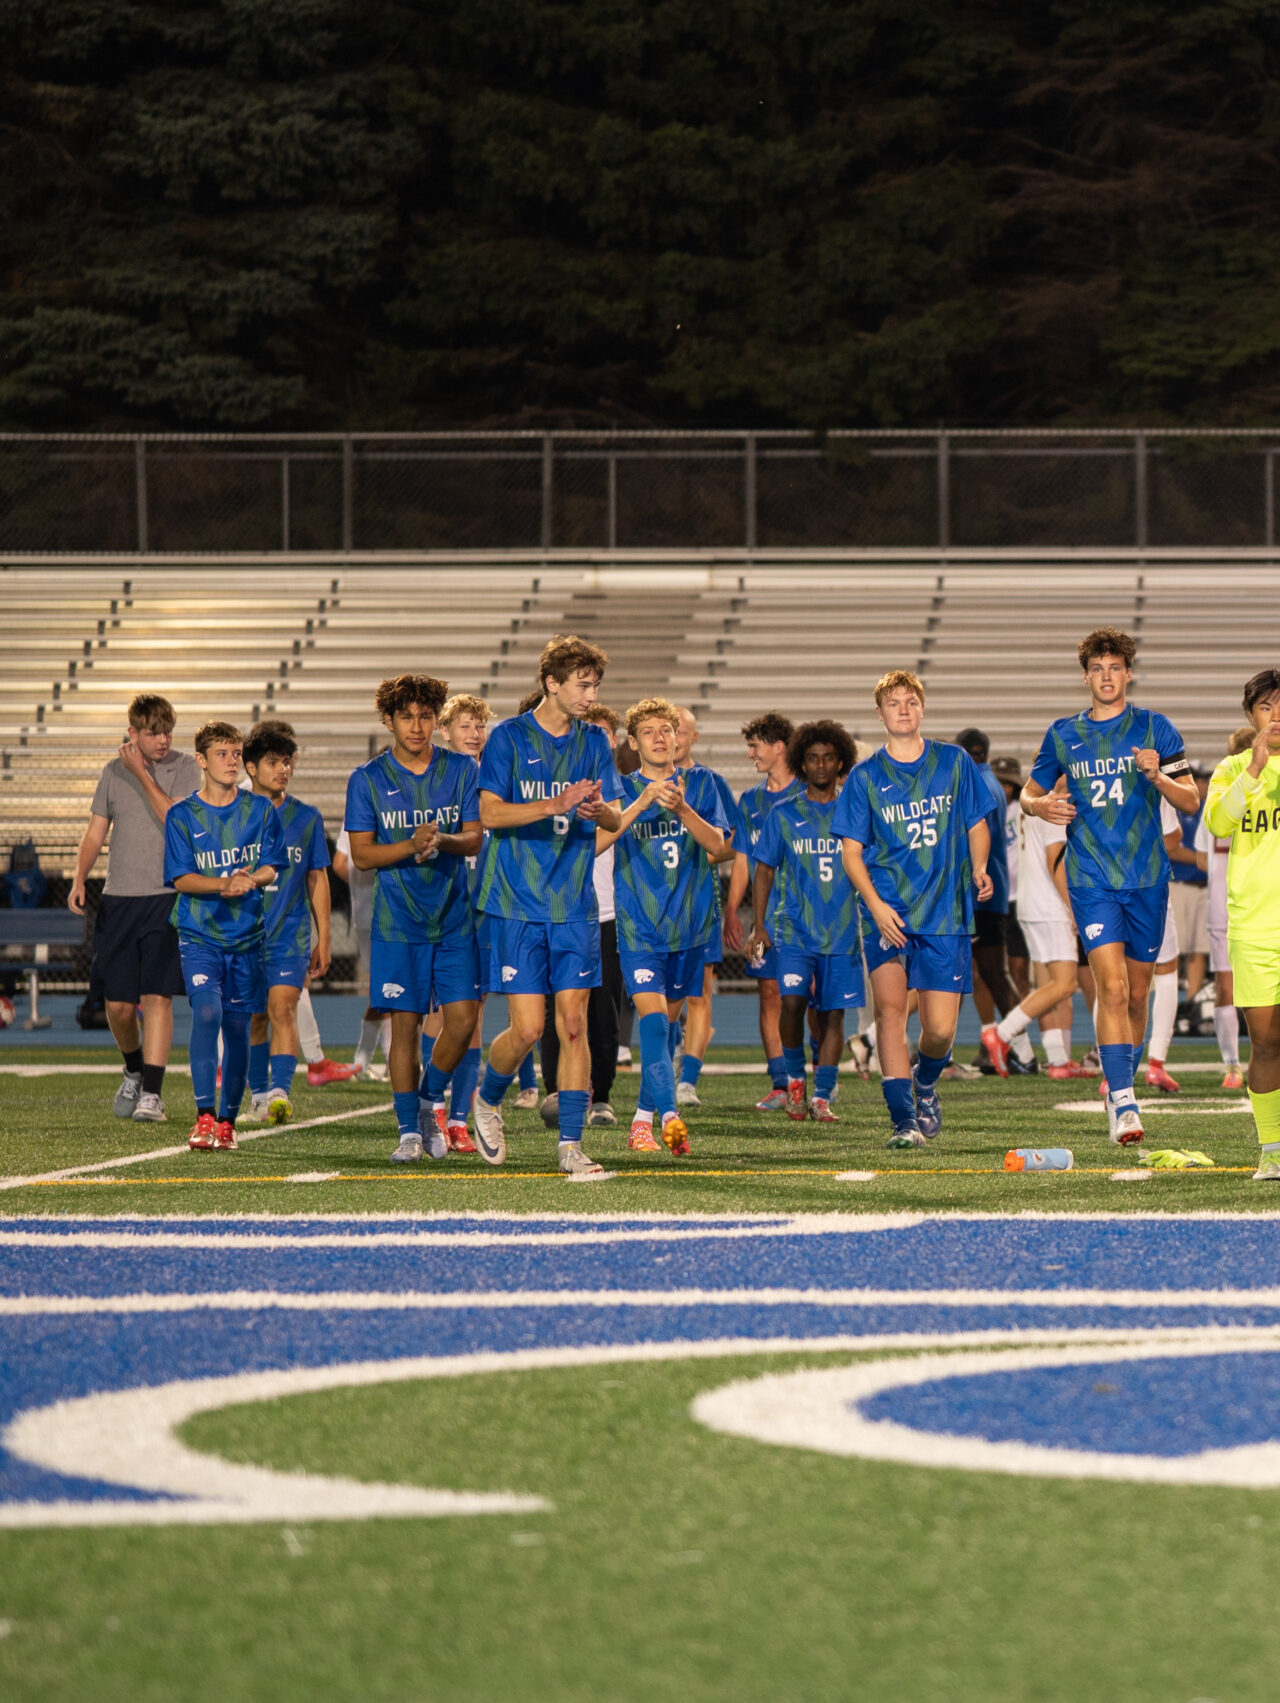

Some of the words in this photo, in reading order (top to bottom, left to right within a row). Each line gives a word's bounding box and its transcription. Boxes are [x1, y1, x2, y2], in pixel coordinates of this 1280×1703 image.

[1068, 756, 1142, 779] WILDCAT
[1090, 778, 1124, 808] 24
[381, 805, 460, 829] WILDCATS
[881, 794, 952, 824] WILDCATS
[630, 819, 688, 840] WILDCA
[906, 818, 938, 850] 25
[662, 840, 680, 869] 3
[792, 838, 844, 855] WILDCA
[818, 856, 834, 882] 5
